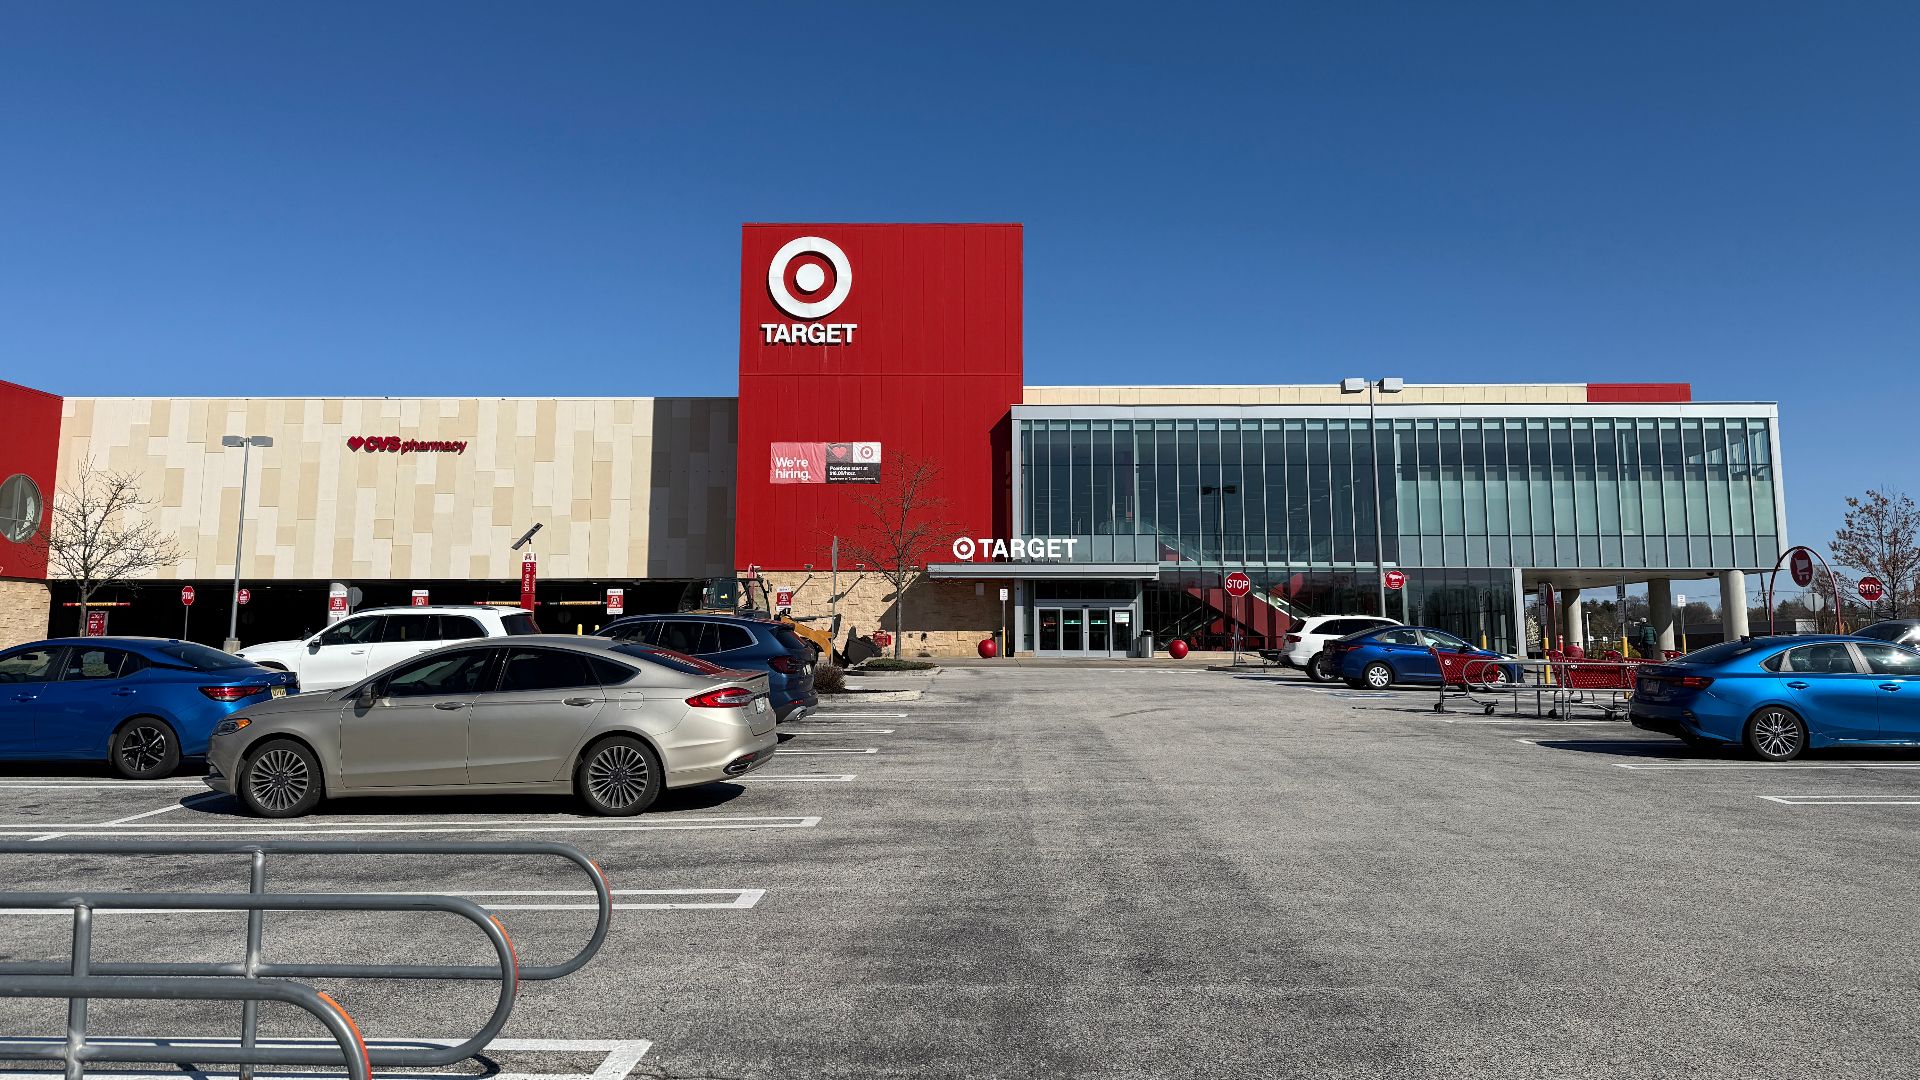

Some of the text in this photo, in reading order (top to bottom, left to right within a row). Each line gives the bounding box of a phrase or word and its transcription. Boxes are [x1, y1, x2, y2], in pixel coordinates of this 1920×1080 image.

[761, 323, 858, 344] TARGET
[364, 436, 468, 455] CVS pharmacy
[775, 457, 809, 468] We're
[775, 468, 812, 481] hiring.
[977, 538, 1078, 558] TARGET
[523, 563, 531, 592] drive up
[1226, 579, 1249, 590] STOP
[1859, 583, 1881, 594] STOP
[183, 591, 194, 599] STOP
